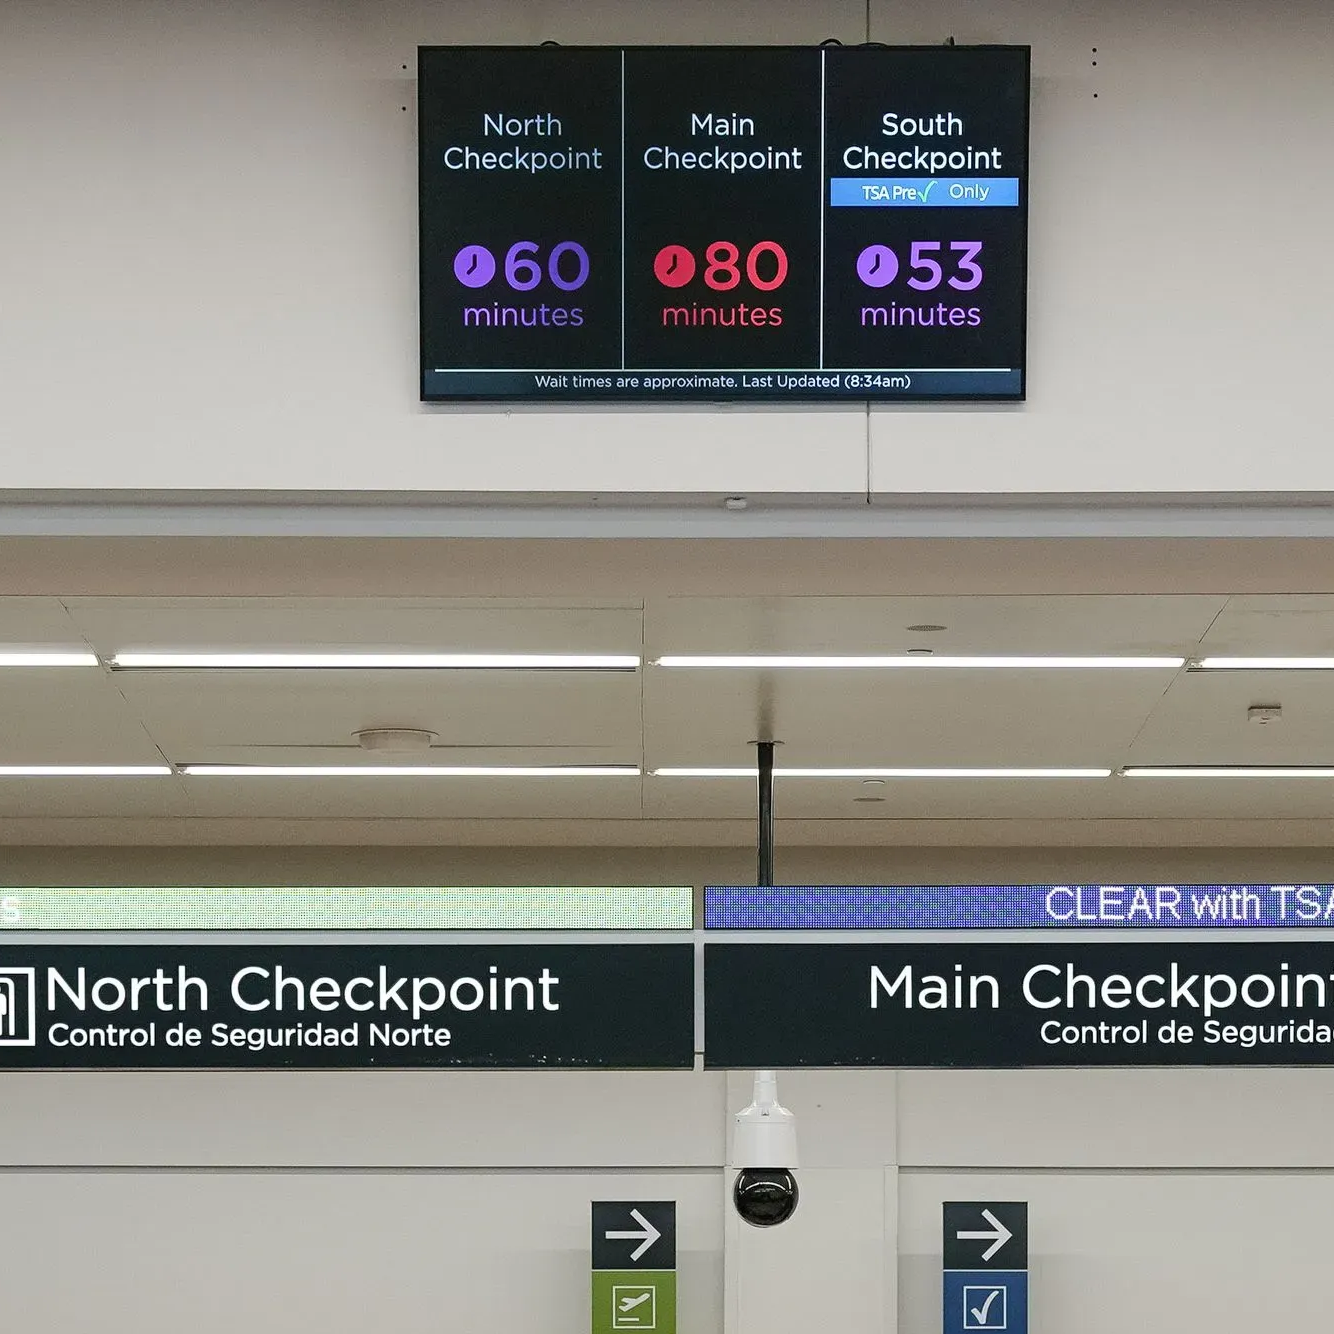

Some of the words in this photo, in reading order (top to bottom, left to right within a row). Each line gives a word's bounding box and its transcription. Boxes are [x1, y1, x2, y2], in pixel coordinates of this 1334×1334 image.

[483, 112, 562, 137] North
[691, 112, 755, 136] Main
[881, 111, 964, 137] South
[443, 146, 603, 174] Checkpoint
[643, 145, 803, 174] Checkpoint
[842, 145, 1003, 174] Checkpoint
[861, 184, 890, 201] TSA
[892, 184, 917, 201] Pre
[948, 183, 990, 202] Only
[503, 240, 590, 292] 60
[703, 240, 789, 292] 80
[905, 240, 984, 292] 53
[463, 301, 584, 327] minutes
[662, 301, 783, 327] minutes
[861, 301, 981, 327] minutes
[534, 374, 568, 389] Wait
[572, 374, 612, 389] times
[616, 377, 640, 389] are
[643, 374, 738, 391] approximate.
[742, 374, 773, 389] Last
[777, 374, 841, 391] Updated
[844, 374, 912, 391] (8:34am)
[1046, 887, 1182, 922] CLEAR
[1190, 887, 1262, 922] with
[47, 965, 208, 1012] North
[229, 965, 561, 1020] Checkpoint
[870, 964, 1000, 1009] Main
[48, 1022, 156, 1047] Control
[165, 1022, 203, 1047] de
[211, 1022, 359, 1051] Seguridad
[369, 1023, 453, 1047] Norte
[1040, 1019, 1148, 1044] Control
[1157, 1019, 1195, 1044] de
